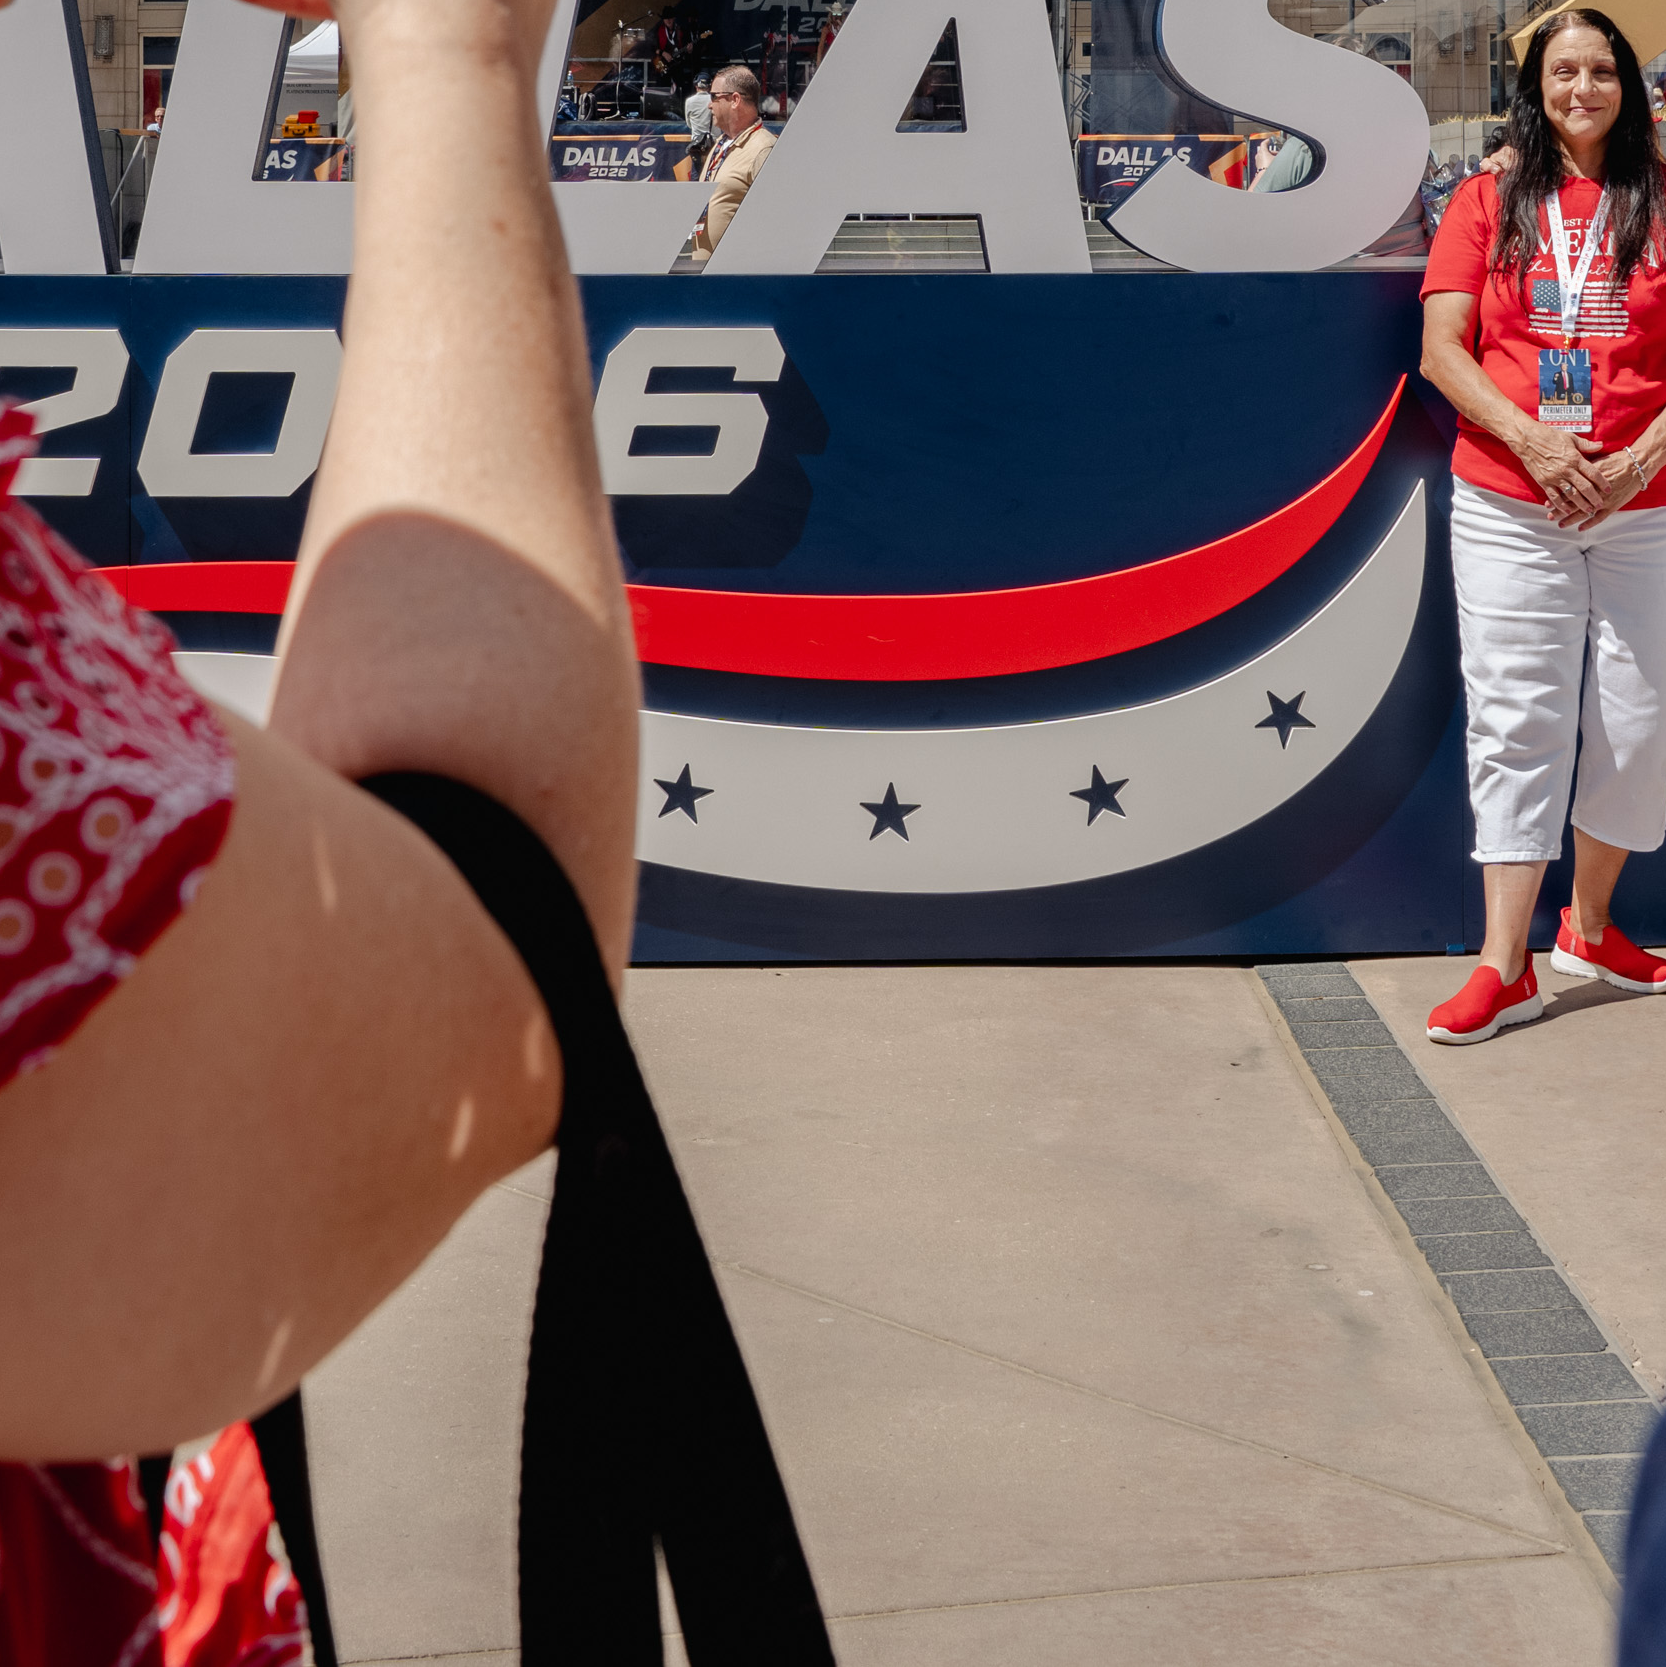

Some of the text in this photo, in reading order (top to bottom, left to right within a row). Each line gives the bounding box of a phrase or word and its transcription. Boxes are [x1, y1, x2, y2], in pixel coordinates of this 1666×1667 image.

[562, 147, 657, 167] DALLAS
[588, 167, 629, 177] 2026
[1543, 406, 1587, 415] PERIMETER ONLY
